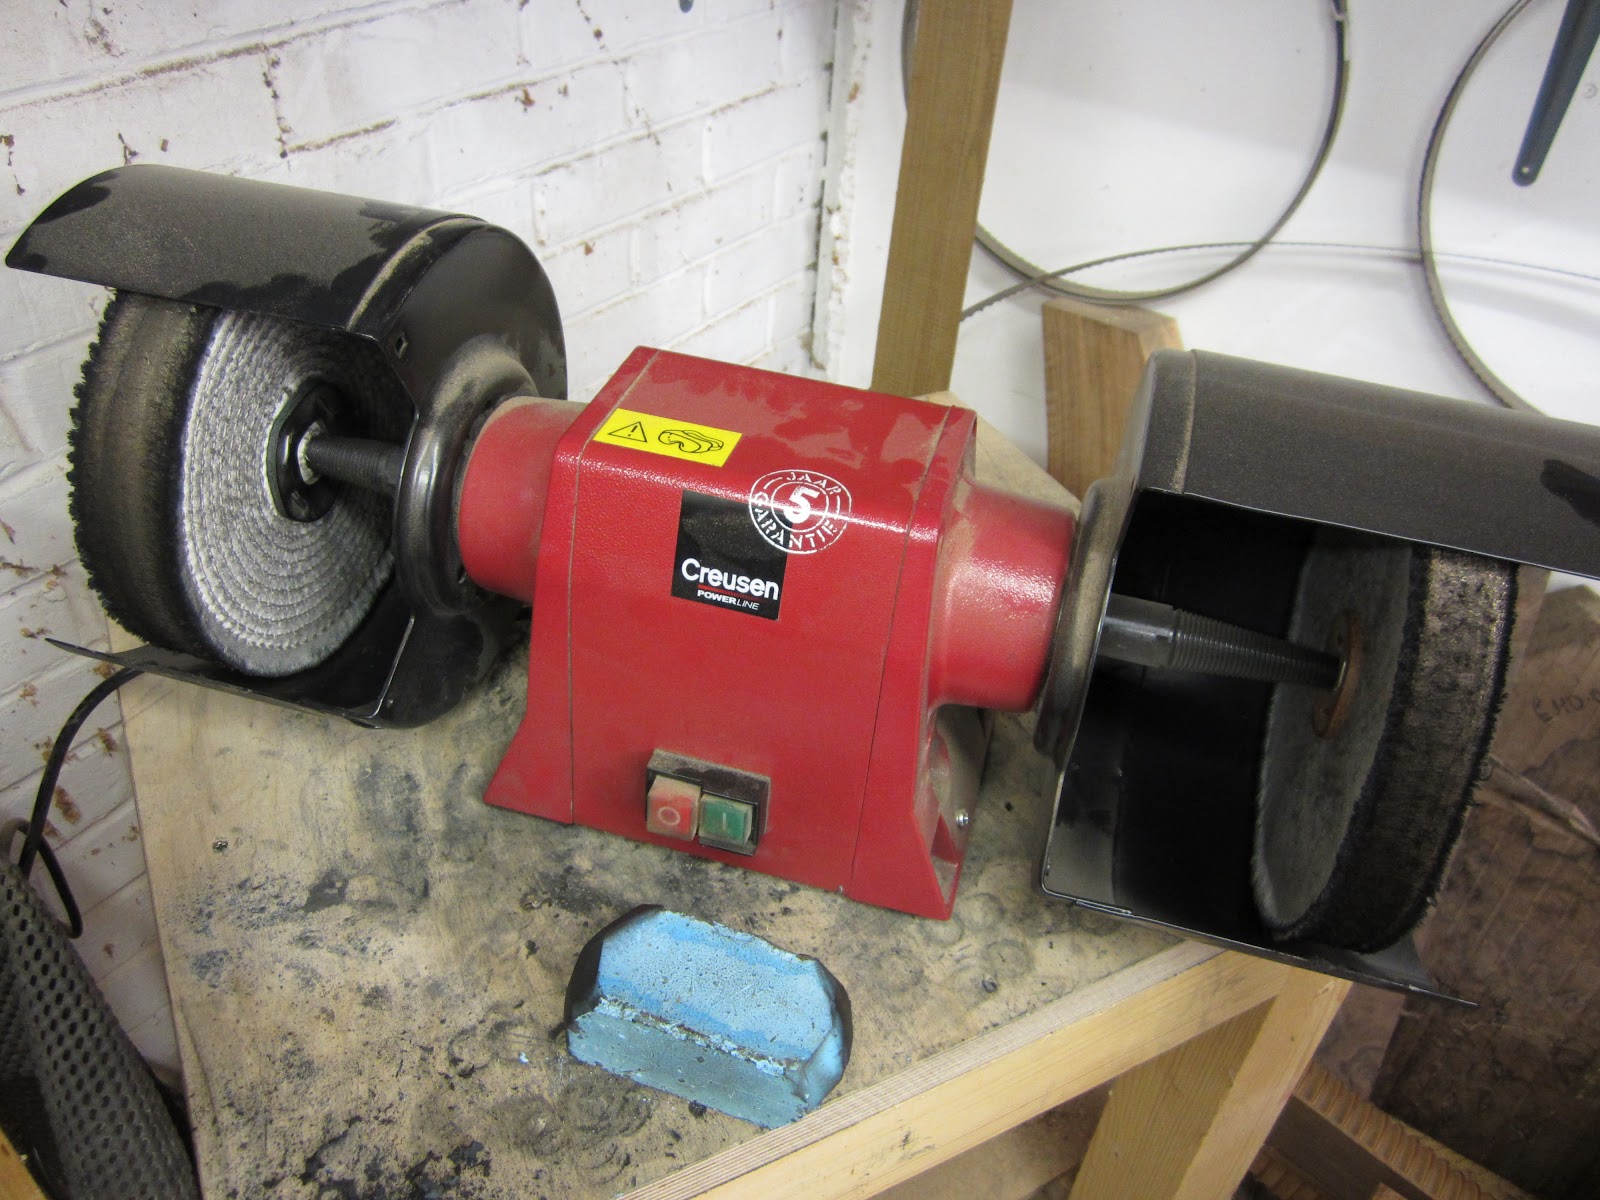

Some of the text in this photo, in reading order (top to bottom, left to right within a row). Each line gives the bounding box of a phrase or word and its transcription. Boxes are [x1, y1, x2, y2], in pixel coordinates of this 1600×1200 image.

[786, 471, 842, 495] JAAR
[754, 492, 837, 549] GARANTIE
[783, 485, 820, 524] 5
[681, 558, 779, 600] Creusen
[697, 590, 760, 611] POWERLINE
